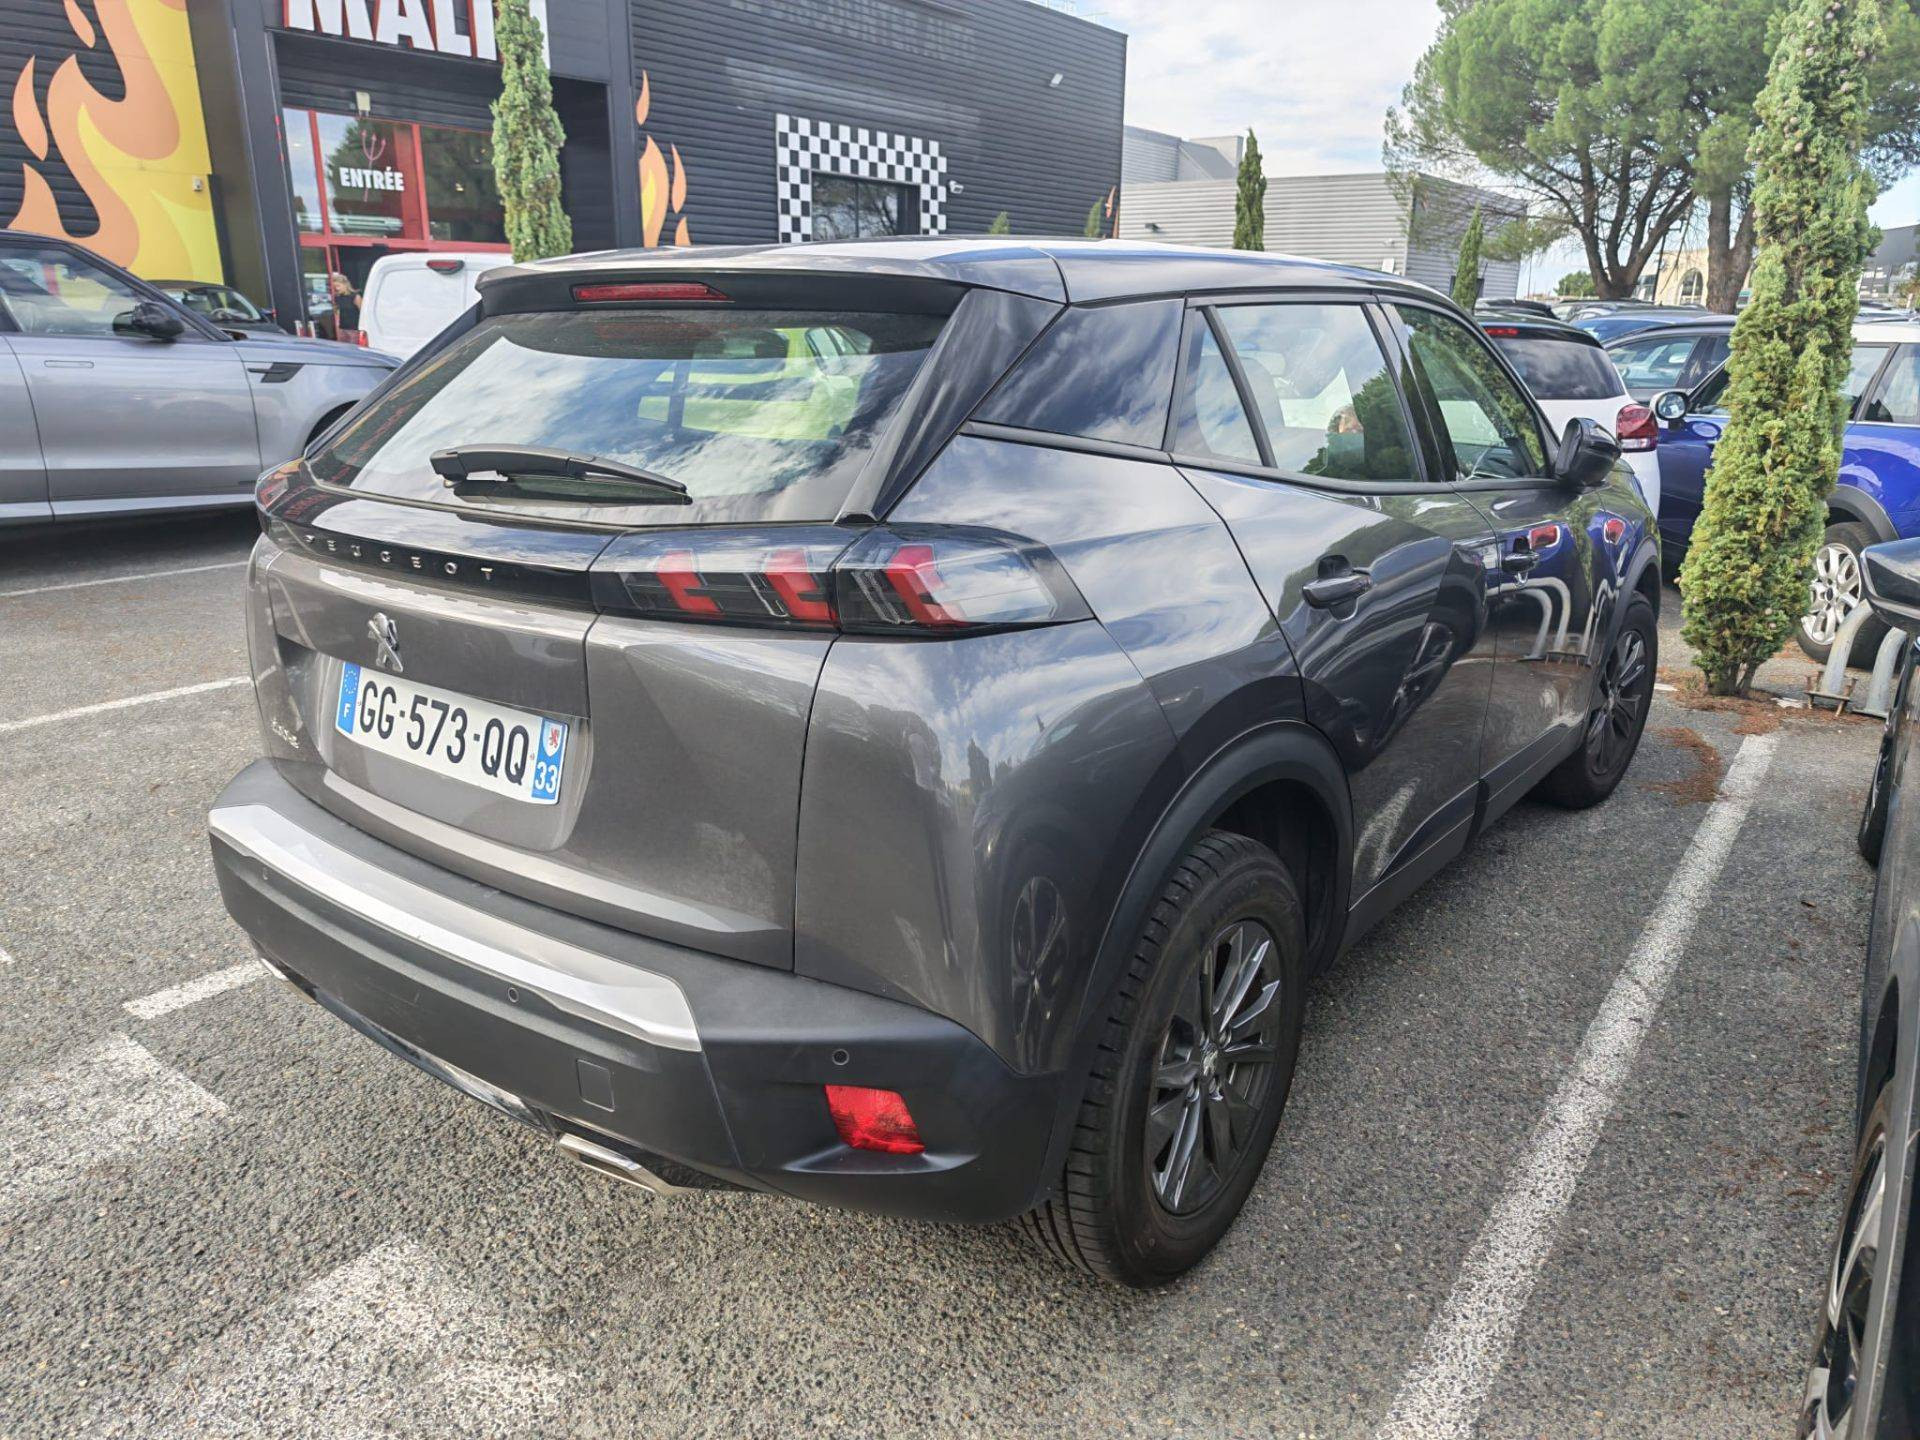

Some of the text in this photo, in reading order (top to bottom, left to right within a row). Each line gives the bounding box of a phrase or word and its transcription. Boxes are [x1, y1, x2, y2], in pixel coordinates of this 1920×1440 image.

[283, 0, 550, 70] MALI
[339, 166, 405, 191] ENTRÉE
[303, 534, 493, 581] PEUGEOT
[343, 703, 351, 718] F
[534, 761, 558, 794] 33
